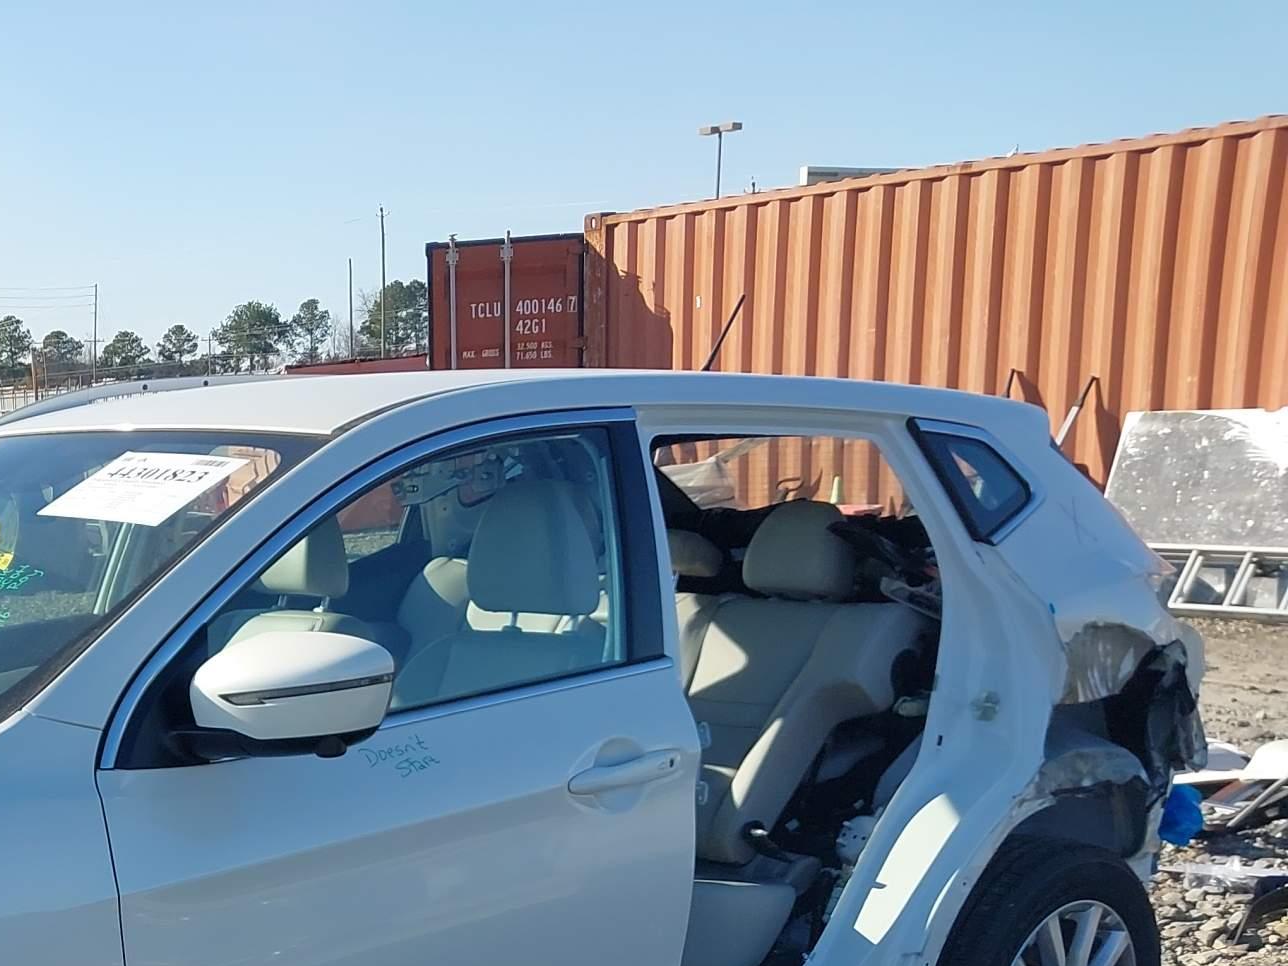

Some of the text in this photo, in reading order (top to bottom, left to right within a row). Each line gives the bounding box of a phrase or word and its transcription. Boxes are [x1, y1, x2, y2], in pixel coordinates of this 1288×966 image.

[470, 302, 501, 318] TCLU
[515, 298, 562, 315] 400146
[515, 319, 546, 334] 42G1
[107, 467, 210, 482] 44301823
